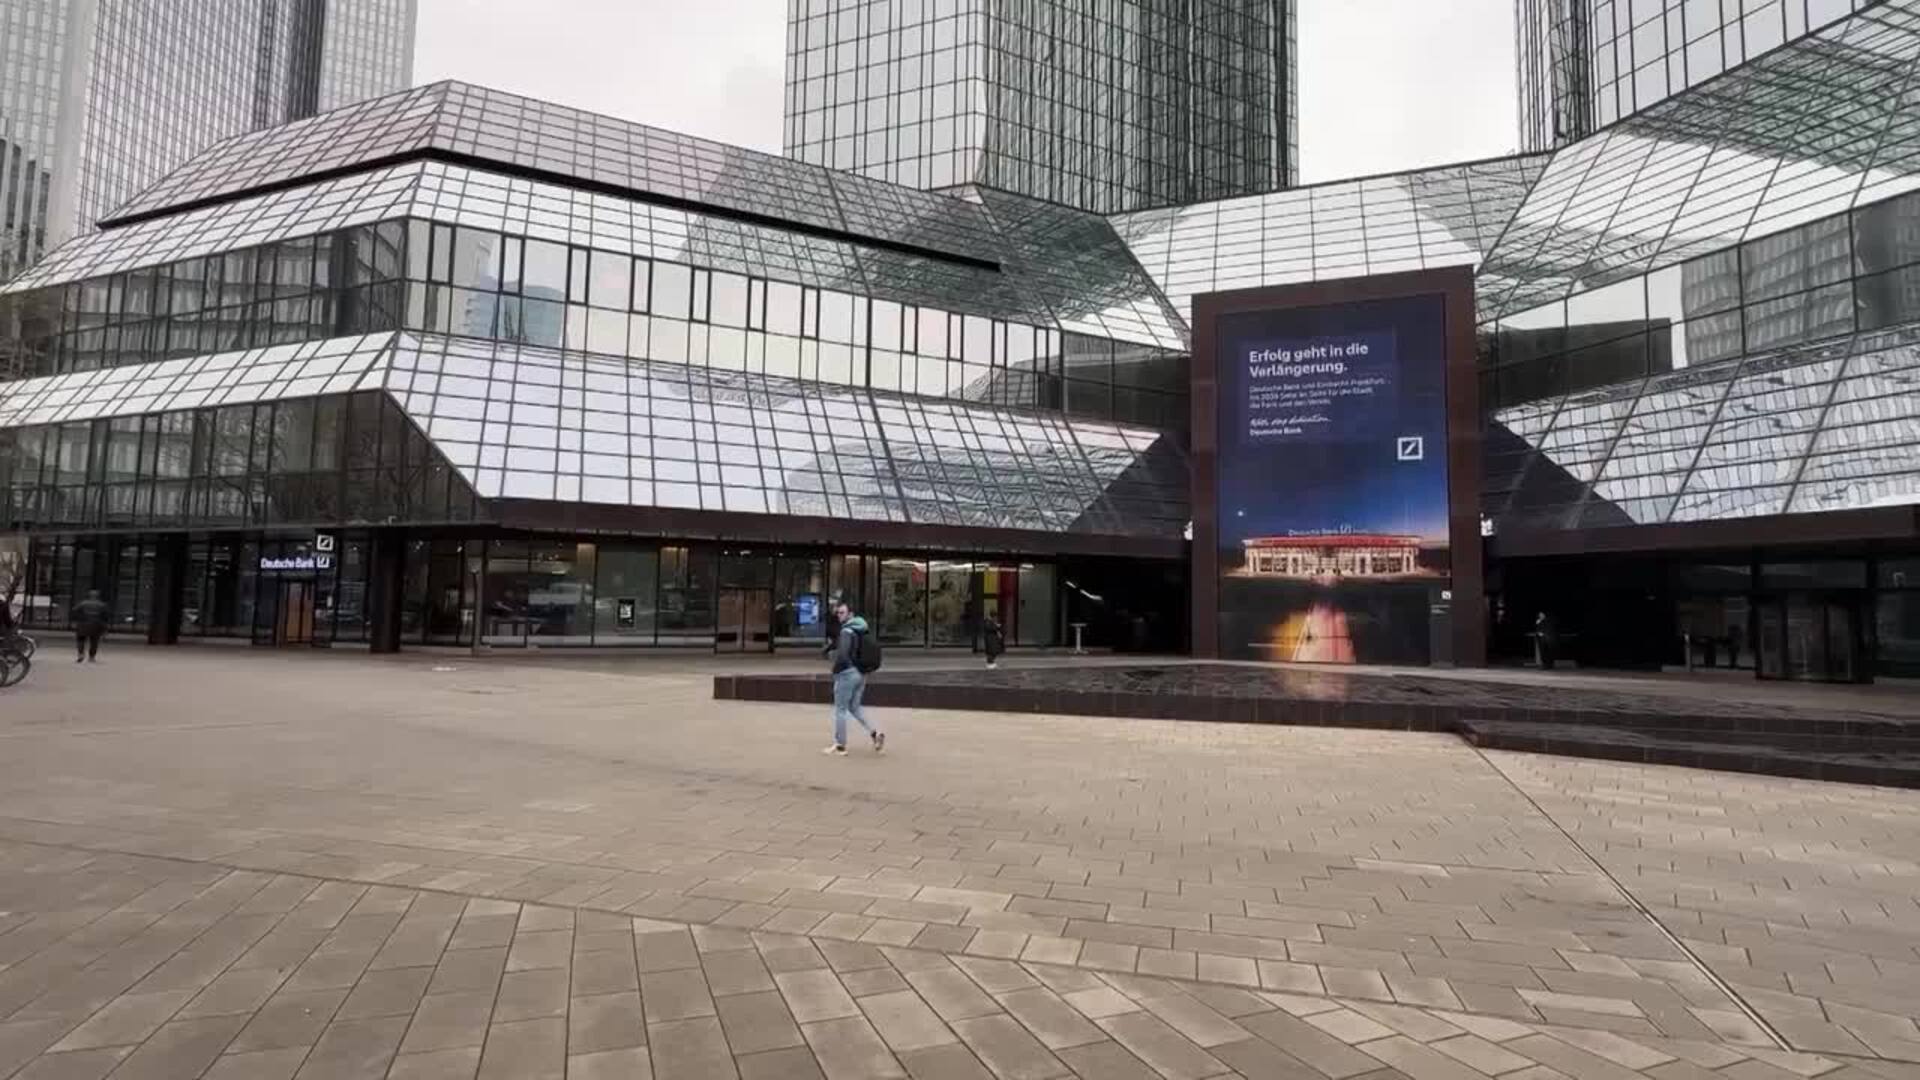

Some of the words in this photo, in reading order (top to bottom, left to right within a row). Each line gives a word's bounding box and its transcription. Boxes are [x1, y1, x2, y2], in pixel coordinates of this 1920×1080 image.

[1249, 348, 1291, 363] Erfolg
[1294, 345, 1327, 361] geht
[1330, 344, 1343, 357] in
[1346, 343, 1368, 355] die
[1249, 361, 1348, 378] Verlängerung.
[1249, 385, 1282, 393] Deutsche
[1250, 428, 1282, 436] Deutsche
[1284, 427, 1302, 435] Bank
[260, 557, 295, 569] Deutsche
[295, 556, 314, 568] Bank
